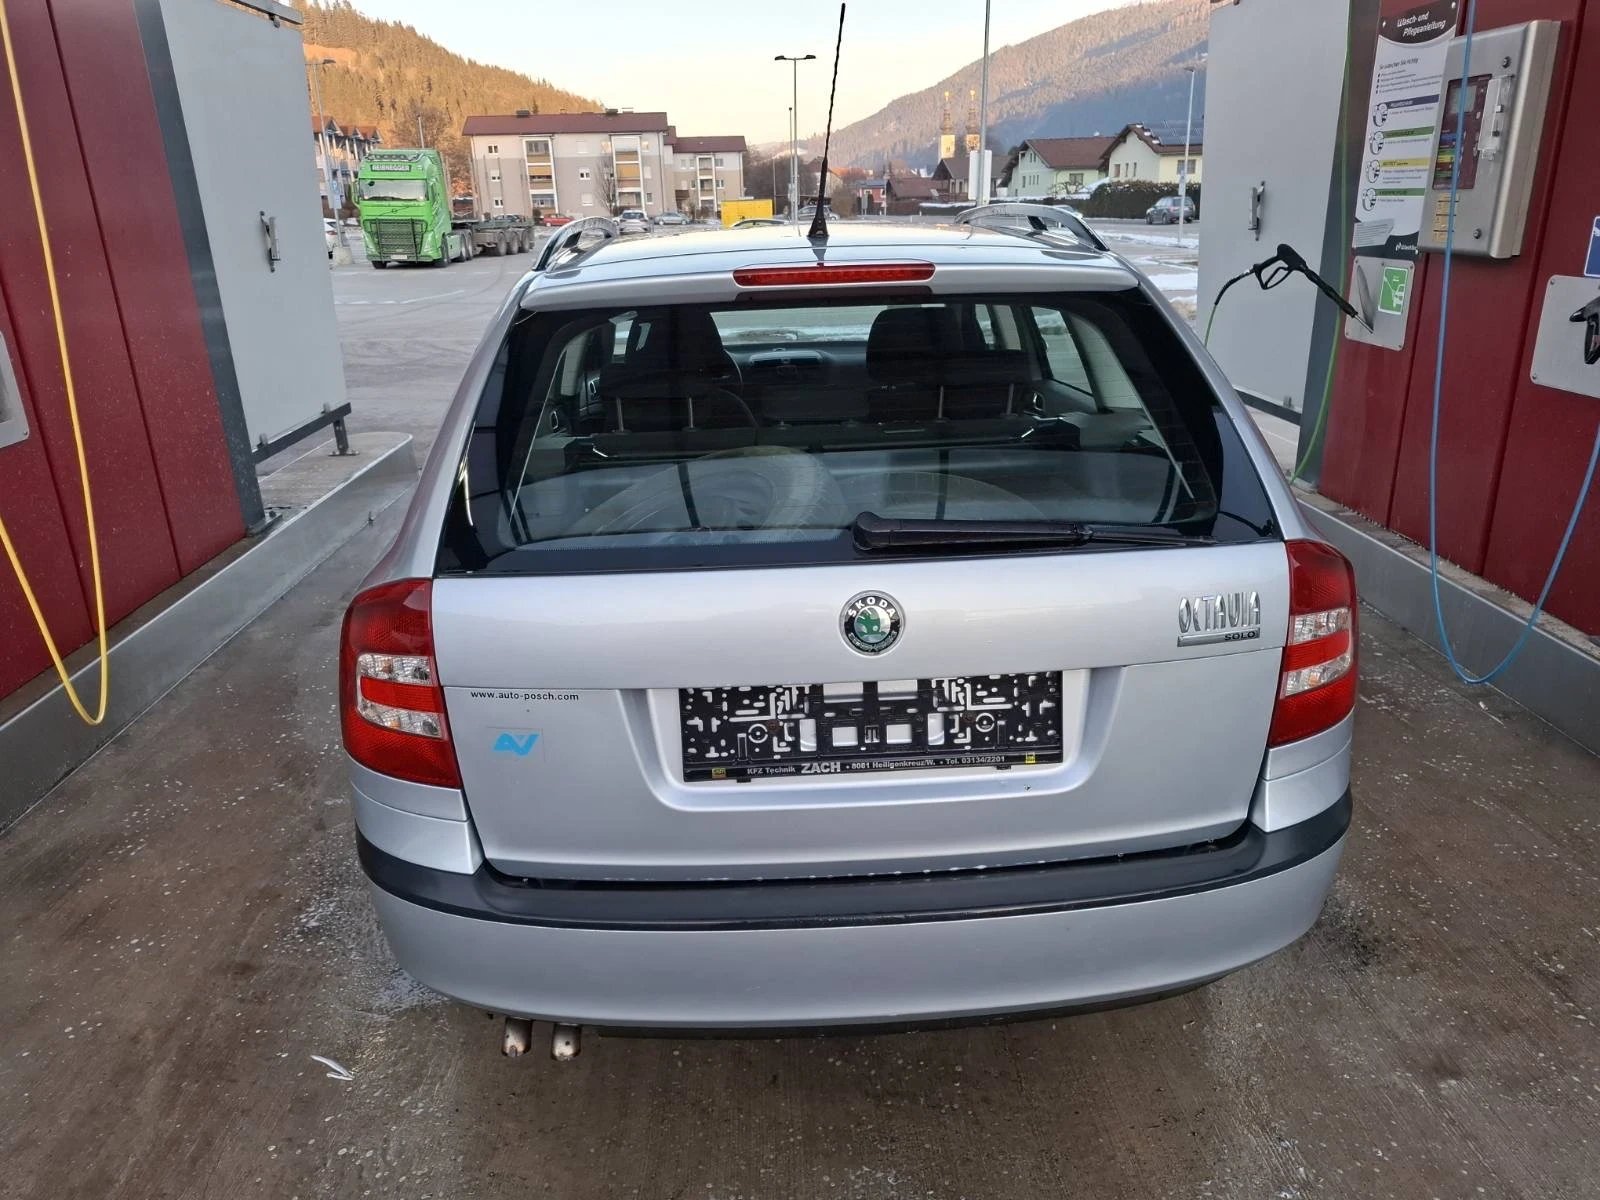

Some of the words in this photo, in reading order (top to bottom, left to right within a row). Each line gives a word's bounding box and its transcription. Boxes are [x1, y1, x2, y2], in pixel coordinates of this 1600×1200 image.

[1418, 11, 1430, 22] und
[1403, 20, 1447, 37] Pflegeanleitung
[1178, 592, 1261, 633] OCTAVIA
[1224, 630, 1256, 641] SOLO
[470, 691, 579, 701] www.auto-posch.com
[747, 767, 763, 775] KFZ
[765, 766, 796, 774] Technik
[801, 761, 841, 774] ZACH
[945, 757, 960, 765] Tel.
[961, 755, 1005, 764] 03134/2201
